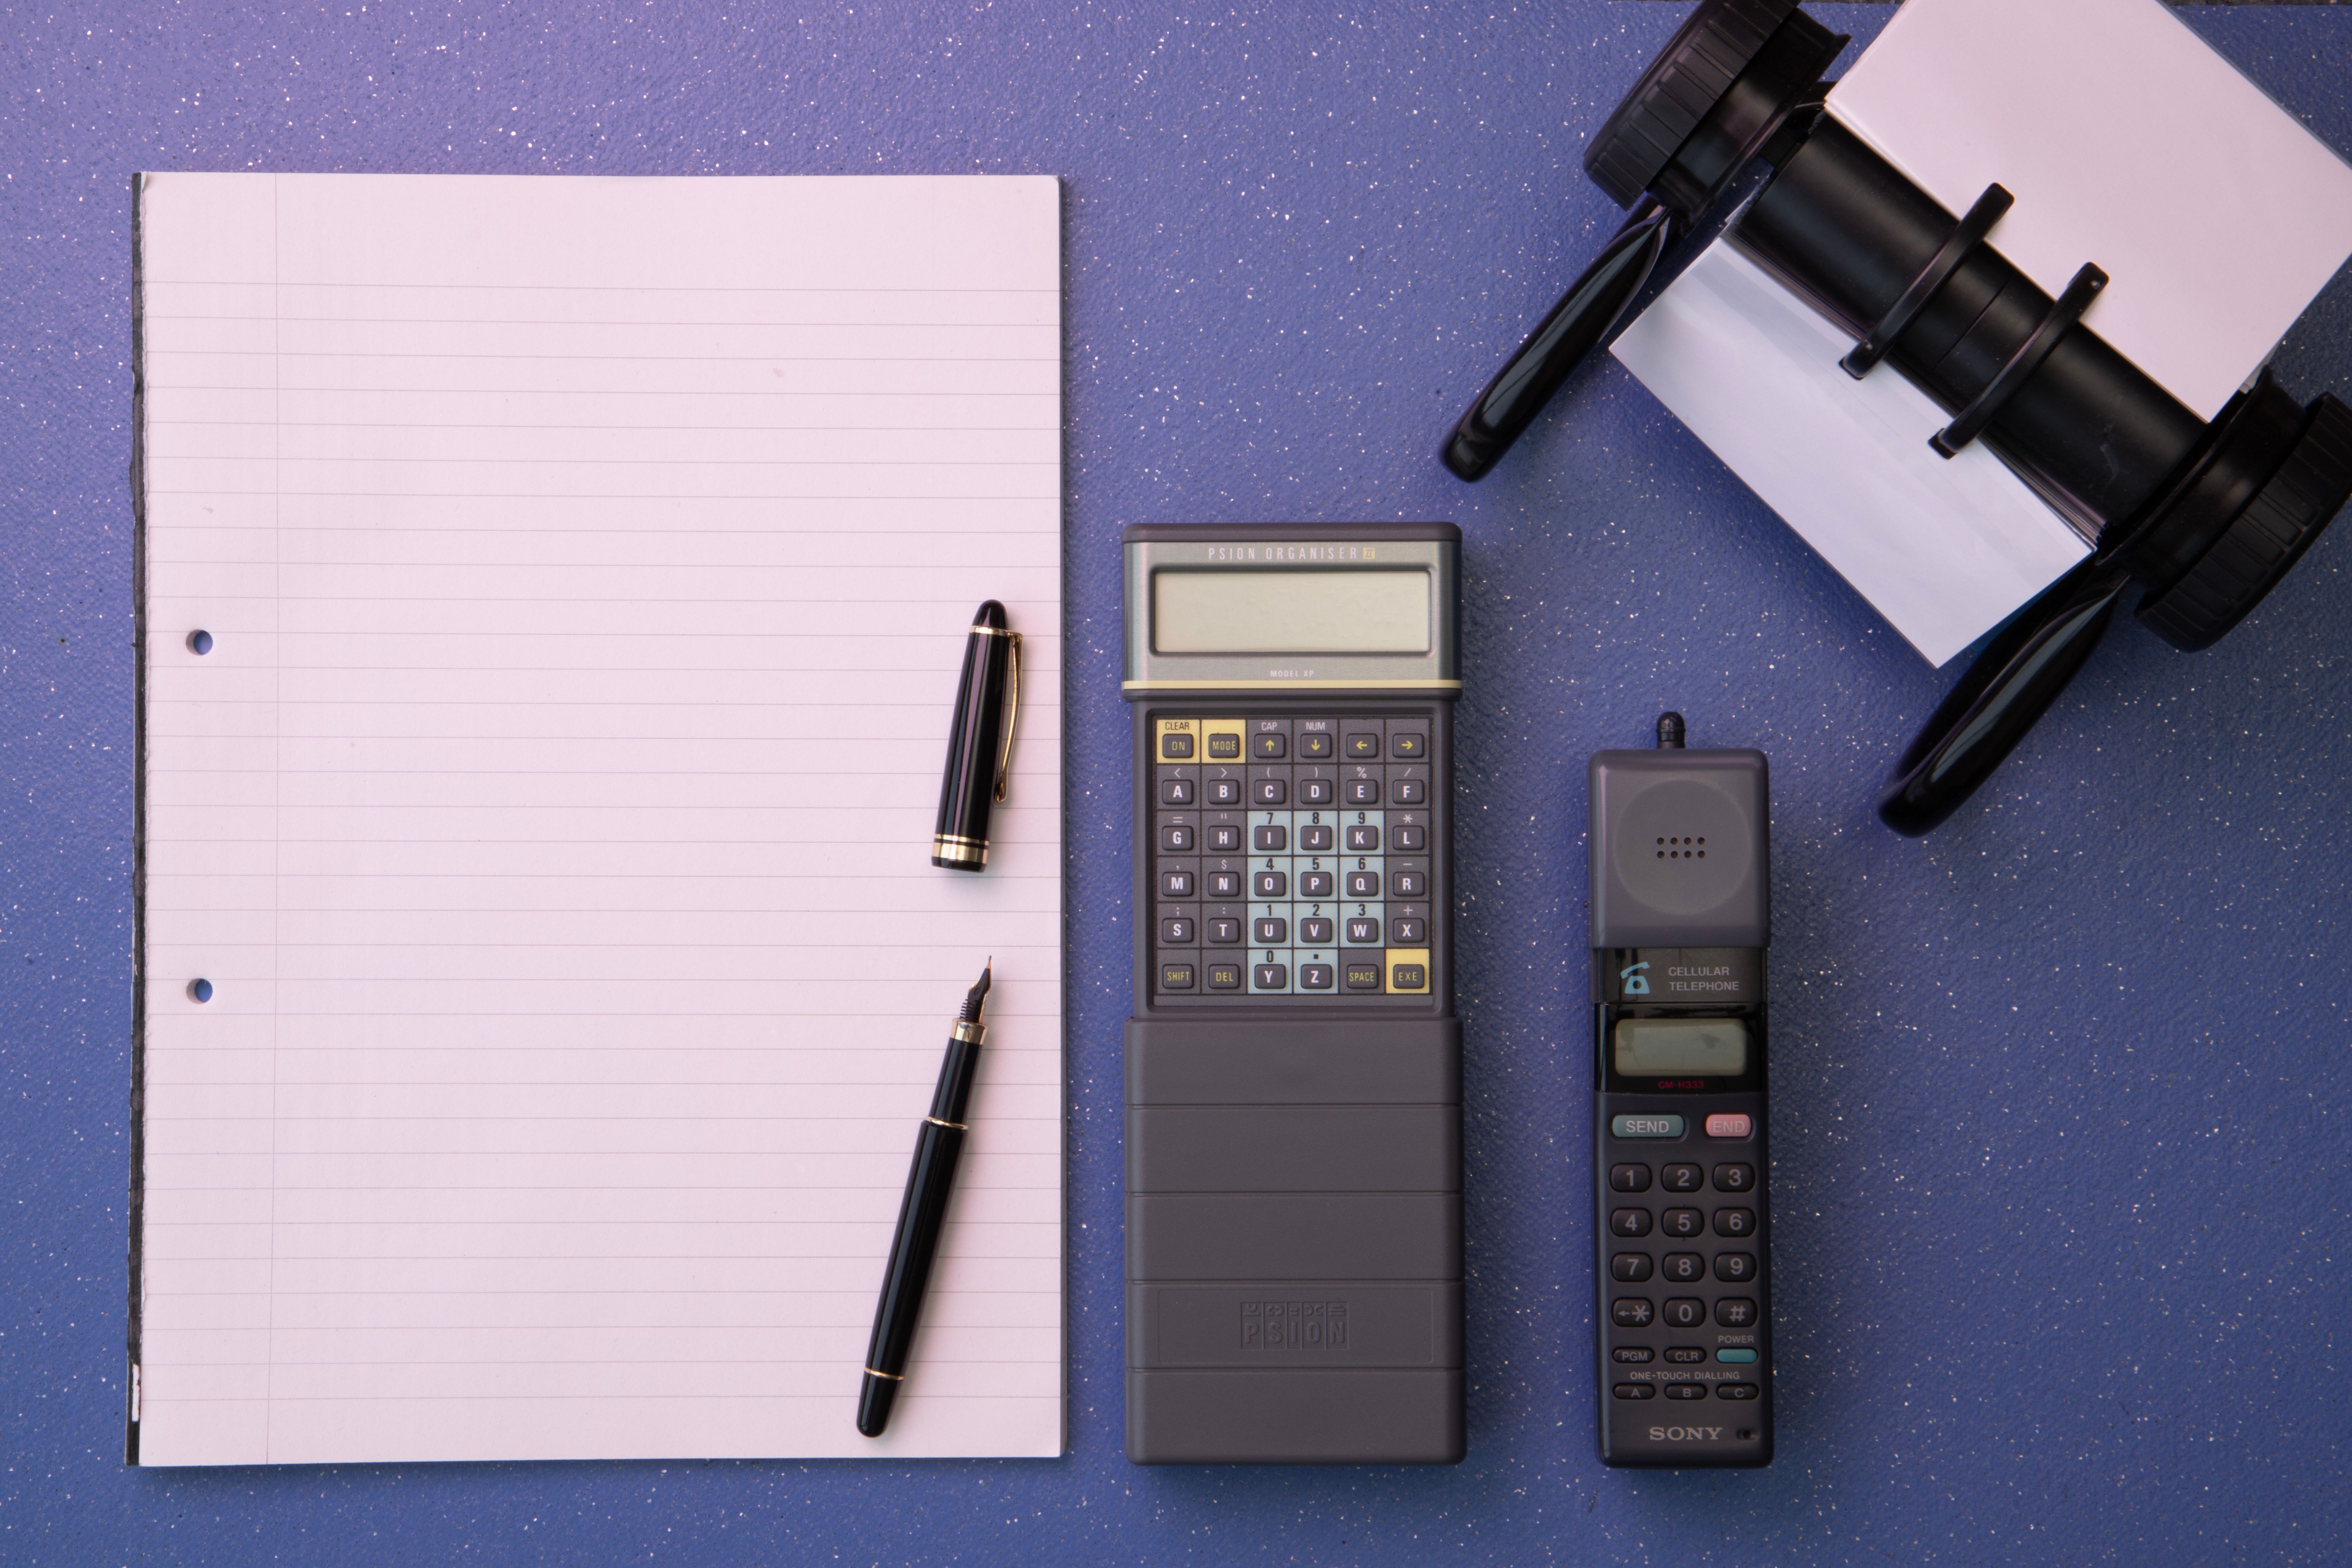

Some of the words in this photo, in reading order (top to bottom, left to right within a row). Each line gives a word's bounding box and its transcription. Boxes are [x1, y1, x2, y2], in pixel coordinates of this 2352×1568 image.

[1208, 547, 1255, 560] PSION
[1266, 547, 1356, 560] ORGANISER
[1165, 721, 1190, 730] CLEAR
[1261, 722, 1277, 731] CAP
[1306, 722, 1325, 730] NUM
[1172, 741, 1185, 750] ON
[1212, 741, 1236, 750] MODE
[1173, 785, 1183, 798] A
[1219, 785, 1228, 798] B
[1265, 785, 1274, 798] C
[1311, 785, 1320, 798] D
[1357, 785, 1364, 798] E
[1403, 786, 1410, 798] F
[1267, 812, 1274, 825] 7
[1312, 811, 1320, 825] 8
[1358, 811, 1366, 824] 9
[1173, 831, 1182, 844] G
[1219, 831, 1228, 844] H
[1267, 832, 1271, 844] I
[1311, 831, 1319, 844] J
[1355, 831, 1364, 844] K
[1403, 832, 1410, 844] L
[1266, 857, 1274, 870] 4
[1312, 857, 1320, 870] 5
[1358, 857, 1366, 870] 6
[1171, 877, 1183, 890] M
[1219, 877, 1228, 890] N
[1264, 877, 1273, 890] O
[1311, 877, 1320, 890] P
[1356, 878, 1366, 891] Q
[1403, 878, 1411, 890] R
[1267, 903, 1272, 916] 1
[1312, 903, 1320, 916] 2
[1358, 903, 1366, 916] 3
[1173, 923, 1181, 936] S
[1219, 924, 1227, 937] T
[1265, 924, 1273, 937] U
[1310, 924, 1319, 937] V
[1353, 925, 1367, 937] W
[1403, 924, 1411, 937] X
[1266, 949, 1274, 963] 0
[1167, 971, 1189, 981] SHIFT
[1216, 972, 1233, 982] DEL
[1264, 971, 1273, 983] Y
[1311, 971, 1319, 983] Z
[1349, 972, 1374, 982] SPACE
[1398, 971, 1417, 982] EXE
[1668, 966, 1729, 976] CELLULAR
[1669, 981, 1738, 991] TELEPHONE
[1626, 1120, 1669, 1133] SEND
[1713, 1121, 1745, 1132] END
[1626, 1170, 1634, 1186] 1
[1677, 1168, 1690, 1186] 2
[1729, 1168, 1741, 1186] 3
[1625, 1214, 1637, 1231] 4
[1678, 1214, 1690, 1231] 5
[1729, 1213, 1742, 1230] 6
[1627, 1258, 1639, 1275] 7
[1678, 1259, 1691, 1276] 8
[1730, 1257, 1743, 1274] 9
[1679, 1304, 1692, 1321] 0
[1244, 1322, 1346, 1344] PSION
[1718, 1335, 1754, 1343] POWER
[1622, 1352, 1648, 1361] PGM
[1675, 1352, 1698, 1361] CLR
[1630, 1371, 1690, 1380] ONE-TOUCH
[1695, 1371, 1740, 1380] DIALLING
[1631, 1388, 1640, 1397] A
[1683, 1388, 1691, 1397] B
[1734, 1388, 1744, 1397] C
[1649, 1427, 1723, 1441] SONY
